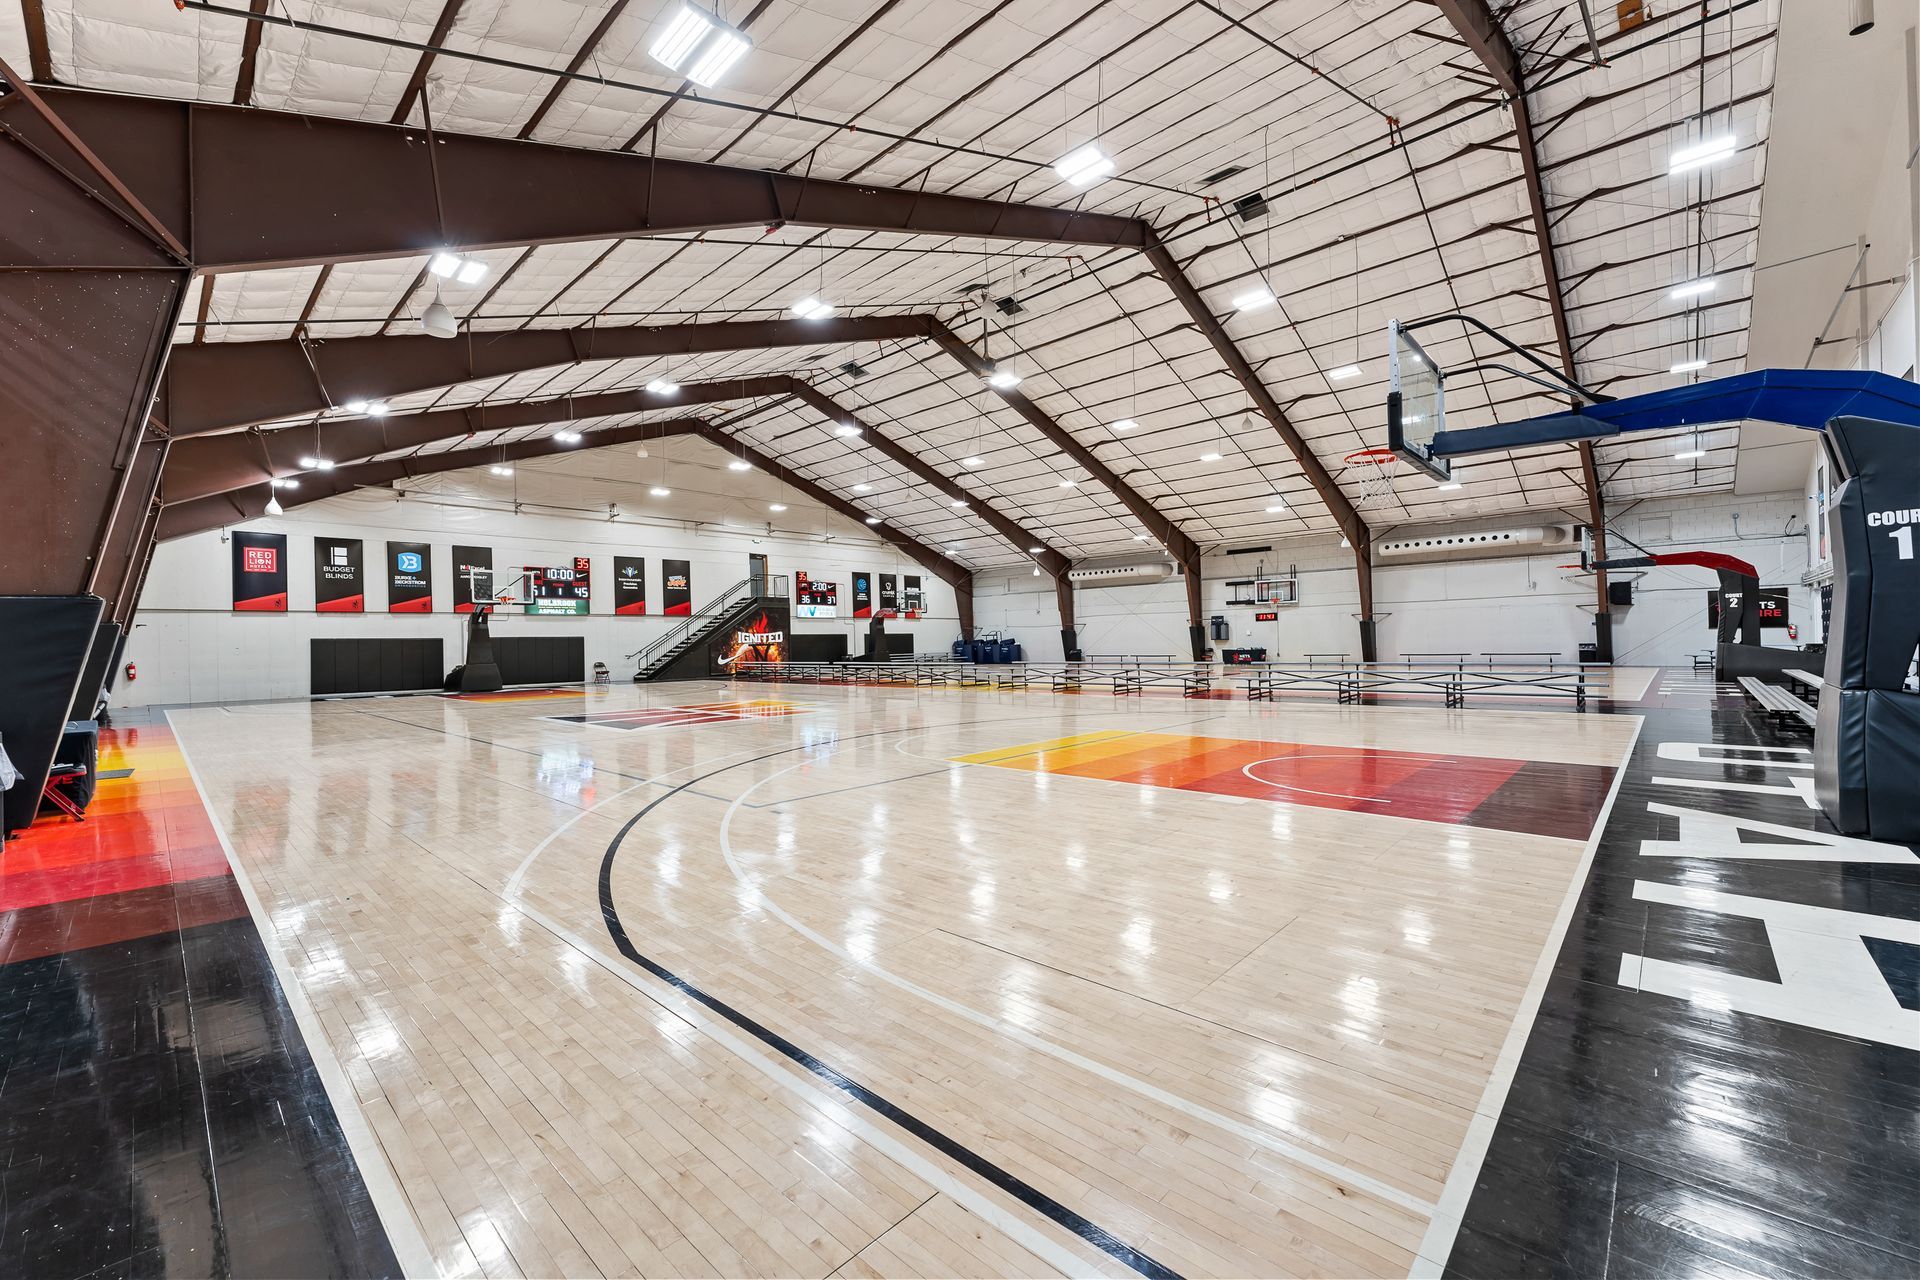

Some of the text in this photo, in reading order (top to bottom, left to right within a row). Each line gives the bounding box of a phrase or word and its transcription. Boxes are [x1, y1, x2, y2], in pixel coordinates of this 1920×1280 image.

[1889, 526, 1914, 560] 1
[248, 551, 272, 559] RED
[576, 558, 589, 569] 35
[547, 568, 574, 580] 10:00
[812, 582, 827, 591] 2:00
[574, 587, 588, 598] 45
[801, 595, 811, 604] 36
[827, 595, 836, 605] 37
[1729, 598, 1738, 608] 2
[737, 631, 783, 644] IGNITED
